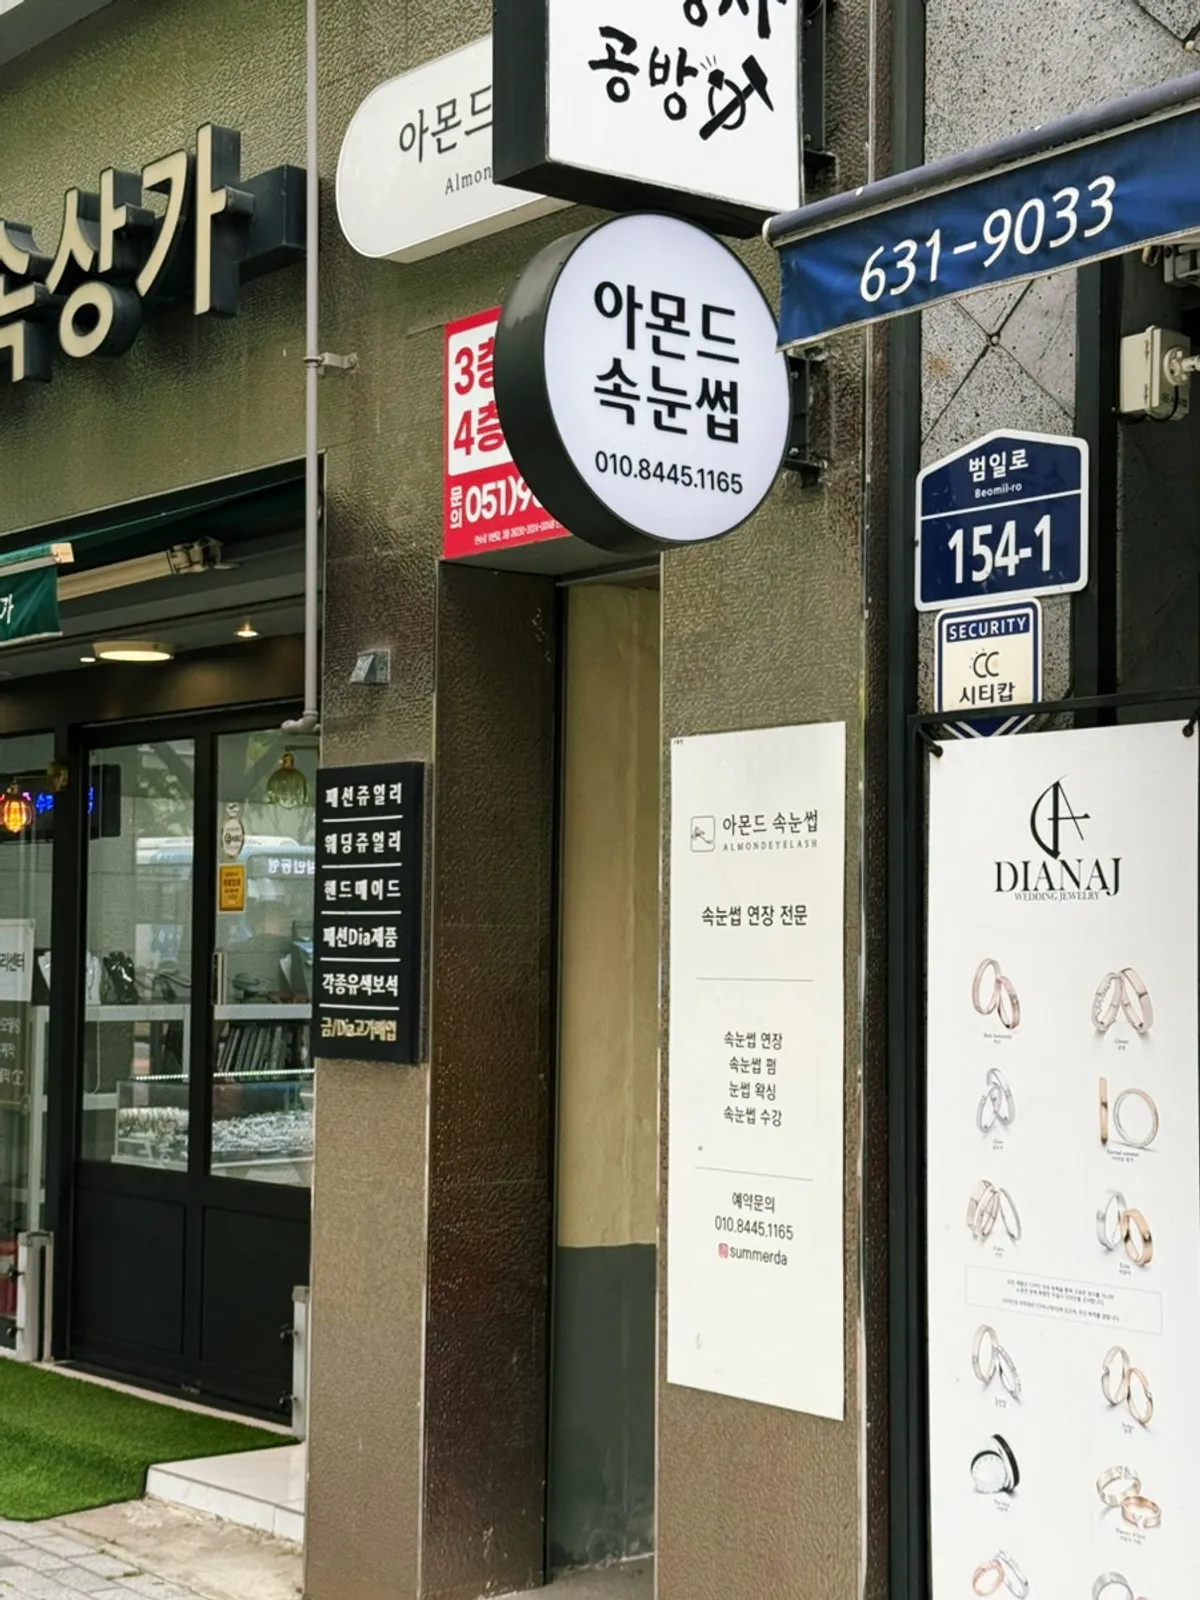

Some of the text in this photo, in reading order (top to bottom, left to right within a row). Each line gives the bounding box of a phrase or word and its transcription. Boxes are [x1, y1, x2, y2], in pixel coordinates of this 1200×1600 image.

[587, 25, 699, 121] 공방
[398, 85, 492, 163] 아몬드
[859, 174, 1117, 303] 631-9033
[593, 280, 740, 364] 아몬드
[593, 356, 740, 444] 속눈썹
[453, 400, 505, 457] 4층
[594, 450, 744, 495] 010.8445.1165
[968, 447, 1030, 483] 범일로
[974, 480, 1023, 499] Beomil-ro
[947, 513, 1054, 585] 154-1
[949, 616, 1027, 640] SECURITY
[958, 681, 1016, 705] 시티캅
[325, 782, 402, 808] 패션쥬얼리
[722, 809, 818, 836] 아몬드 속눈썹
[324, 830, 401, 855] 웨딩쥬얼리
[993, 857, 1121, 897] DIANAJ
[1014, 890, 1100, 903] WEDDING JEWELRY
[702, 904, 808, 927] 속눈썹 연장 전문
[322, 973, 398, 997] 각종유색보석
[724, 1031, 783, 1050] 속눈썹 연장
[729, 1056, 777, 1076] 속눈썹 펌
[729, 1081, 777, 1101] 눈썹 왁싱
[724, 1106, 783, 1127] 속눈썹 수강
[732, 1192, 776, 1213] 예약문의
[714, 1215, 794, 1241] 010.8445.1165
[729, 1246, 788, 1266] summerda
